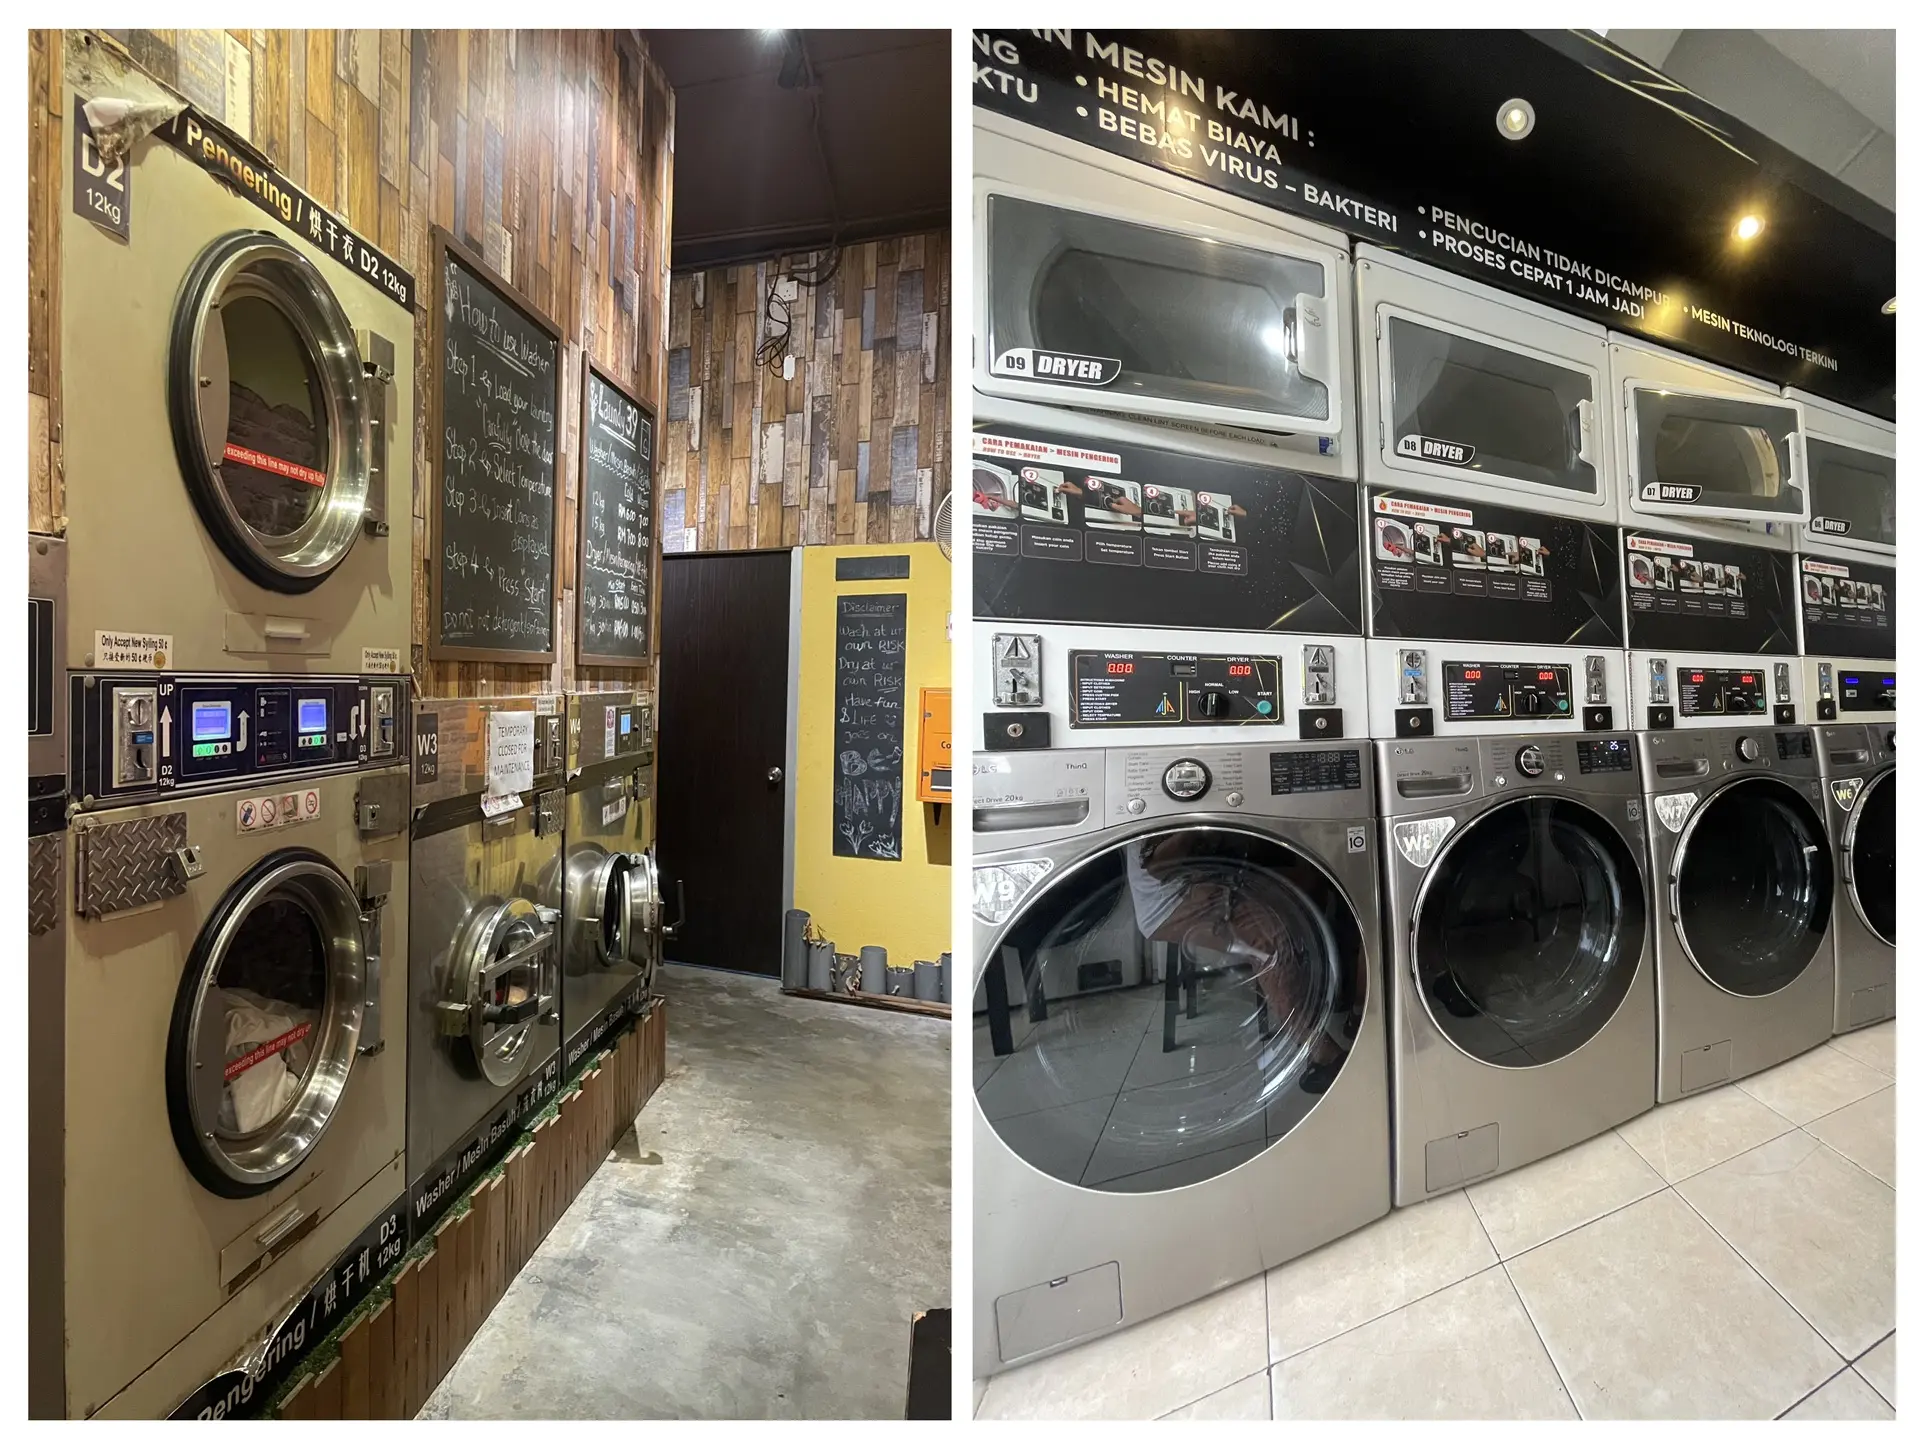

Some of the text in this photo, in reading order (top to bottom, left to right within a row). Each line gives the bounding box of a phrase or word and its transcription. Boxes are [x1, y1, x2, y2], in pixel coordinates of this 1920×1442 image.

[1086, 31, 1207, 104] MESIN
[1216, 83, 1300, 141] KAMI
[1098, 76, 1283, 166] HEMAT BIAYA
[82, 133, 124, 191] D2
[1099, 107, 1399, 233] BEBAS VIRUS BAKTERI
[86, 187, 121, 225] 12kg
[308, 206, 354, 264] 烘干衣
[360, 247, 379, 279] D2
[382, 268, 407, 302] 12kg
[1431, 204, 1671, 309] PENCUCIAN TIDAK DICAMPUR
[1432, 230, 1645, 320] PROSES CEPAT 1 JAM JADI
[459, 285, 488, 335] How
[1691, 304, 1838, 372] MESIN TEKNOLOGI TERKINI
[446, 337, 468, 394] Step
[1005, 355, 1027, 371] D9
[1037, 355, 1104, 381] DRYER
[445, 426, 466, 475] Step
[982, 436, 1120, 465] CARA PEMAKAIAN MESIN PENGERING
[1404, 439, 1417, 452] D8
[1423, 440, 1464, 461] DRYER
[445, 475, 465, 517] Step
[1661, 486, 1694, 499] DRYER
[1824, 519, 1846, 533] DRYER
[445, 541, 468, 578] Step
[470, 545, 479, 575] 4
[842, 600, 900, 614] Disclaimer
[840, 623, 871, 638] Wash
[873, 623, 887, 637] at
[101, 634, 164, 650] Only Accept New 50
[844, 639, 905, 653] own RISK
[838, 656, 860, 674] Dry
[861, 658, 876, 670] at
[159, 683, 174, 696] UP
[842, 672, 903, 688] own RISK
[844, 693, 902, 710] Have fun
[498, 725, 529, 738] TEMPORARY
[569, 717, 581, 735] W4
[417, 733, 438, 757] W3
[498, 742, 528, 757] CLOSED FOR
[161, 765, 173, 776] D2
[420, 762, 435, 776] 12kg
[493, 761, 531, 776] MAINTENANCE
[158, 777, 175, 787] 12kg
[835, 775, 901, 829] HAPPY
[1835, 789, 1853, 802] W6
[1402, 833, 1433, 852] W8
[568, 1037, 590, 1067] Washer
[545, 1060, 556, 1081] W3
[543, 1079, 556, 1097] 12kg
[415, 1168, 458, 1218] Washer
[462, 1135, 489, 1174] Mesin
[490, 1105, 516, 1146] Basuh
[380, 1213, 397, 1245] D3
[376, 1237, 401, 1269] 12kg
[323, 1246, 370, 1318] 烘干机
